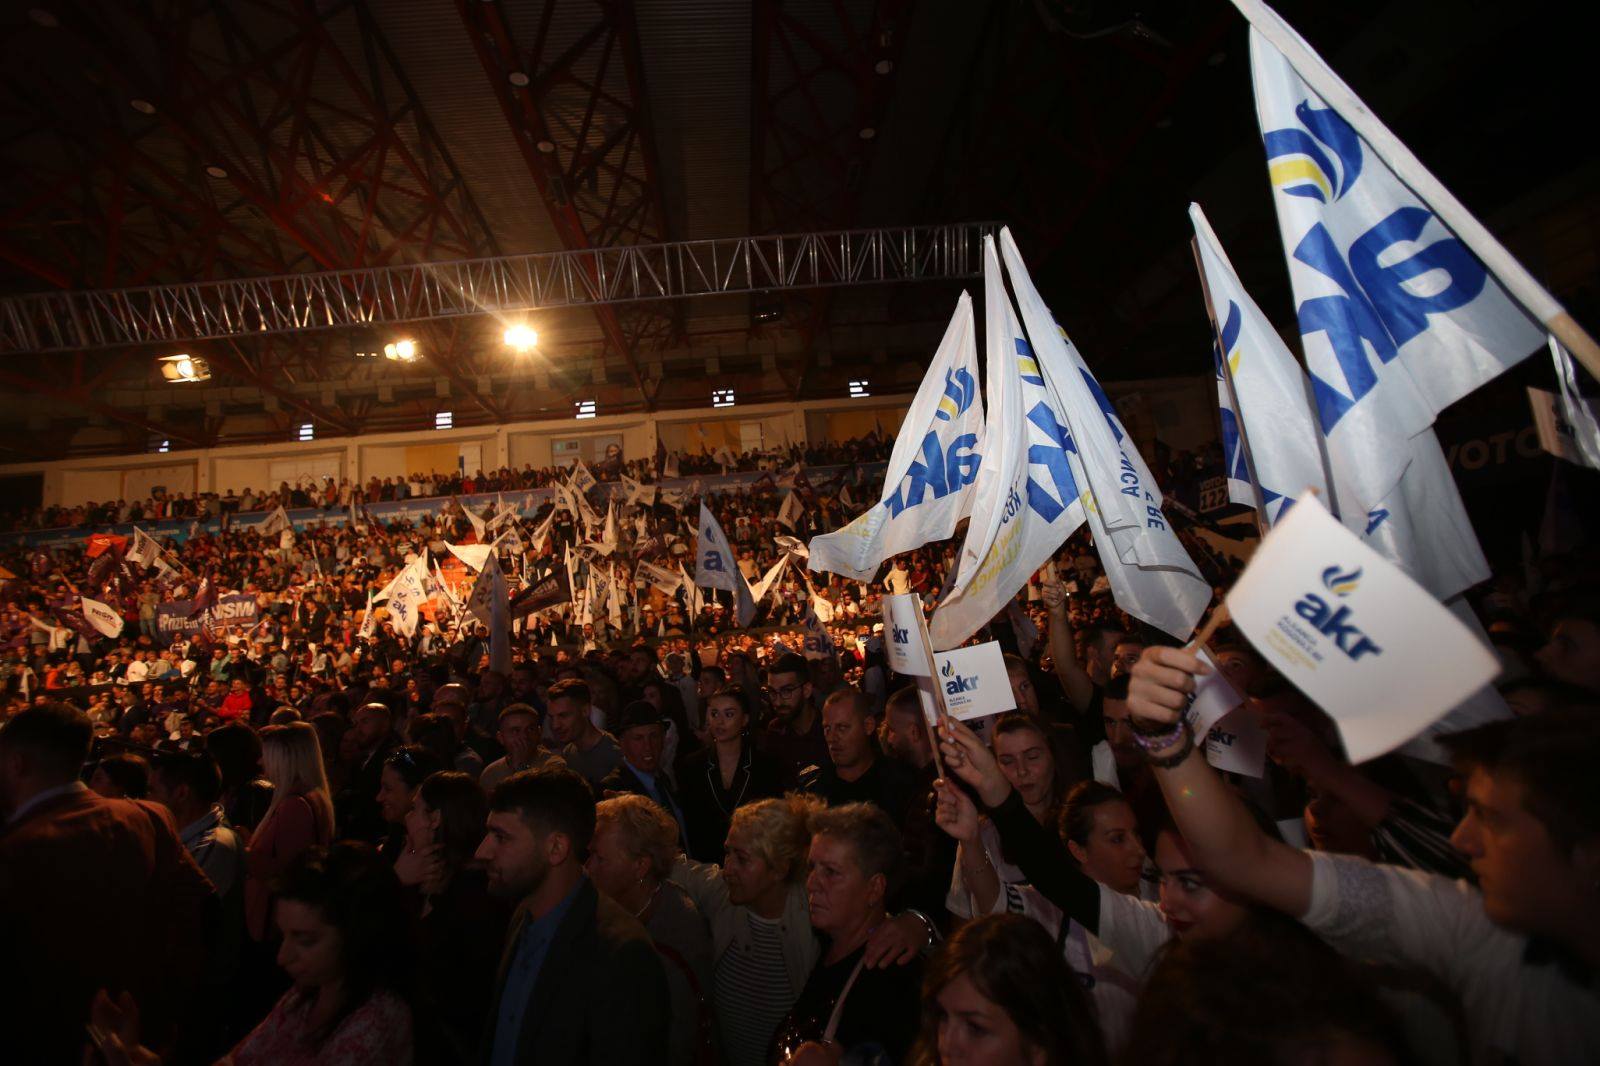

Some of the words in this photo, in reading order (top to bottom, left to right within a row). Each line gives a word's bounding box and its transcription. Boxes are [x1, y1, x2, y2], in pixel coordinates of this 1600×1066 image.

[892, 623, 909, 643] akr
[1295, 593, 1382, 661] akr
[946, 674, 979, 695] akr
